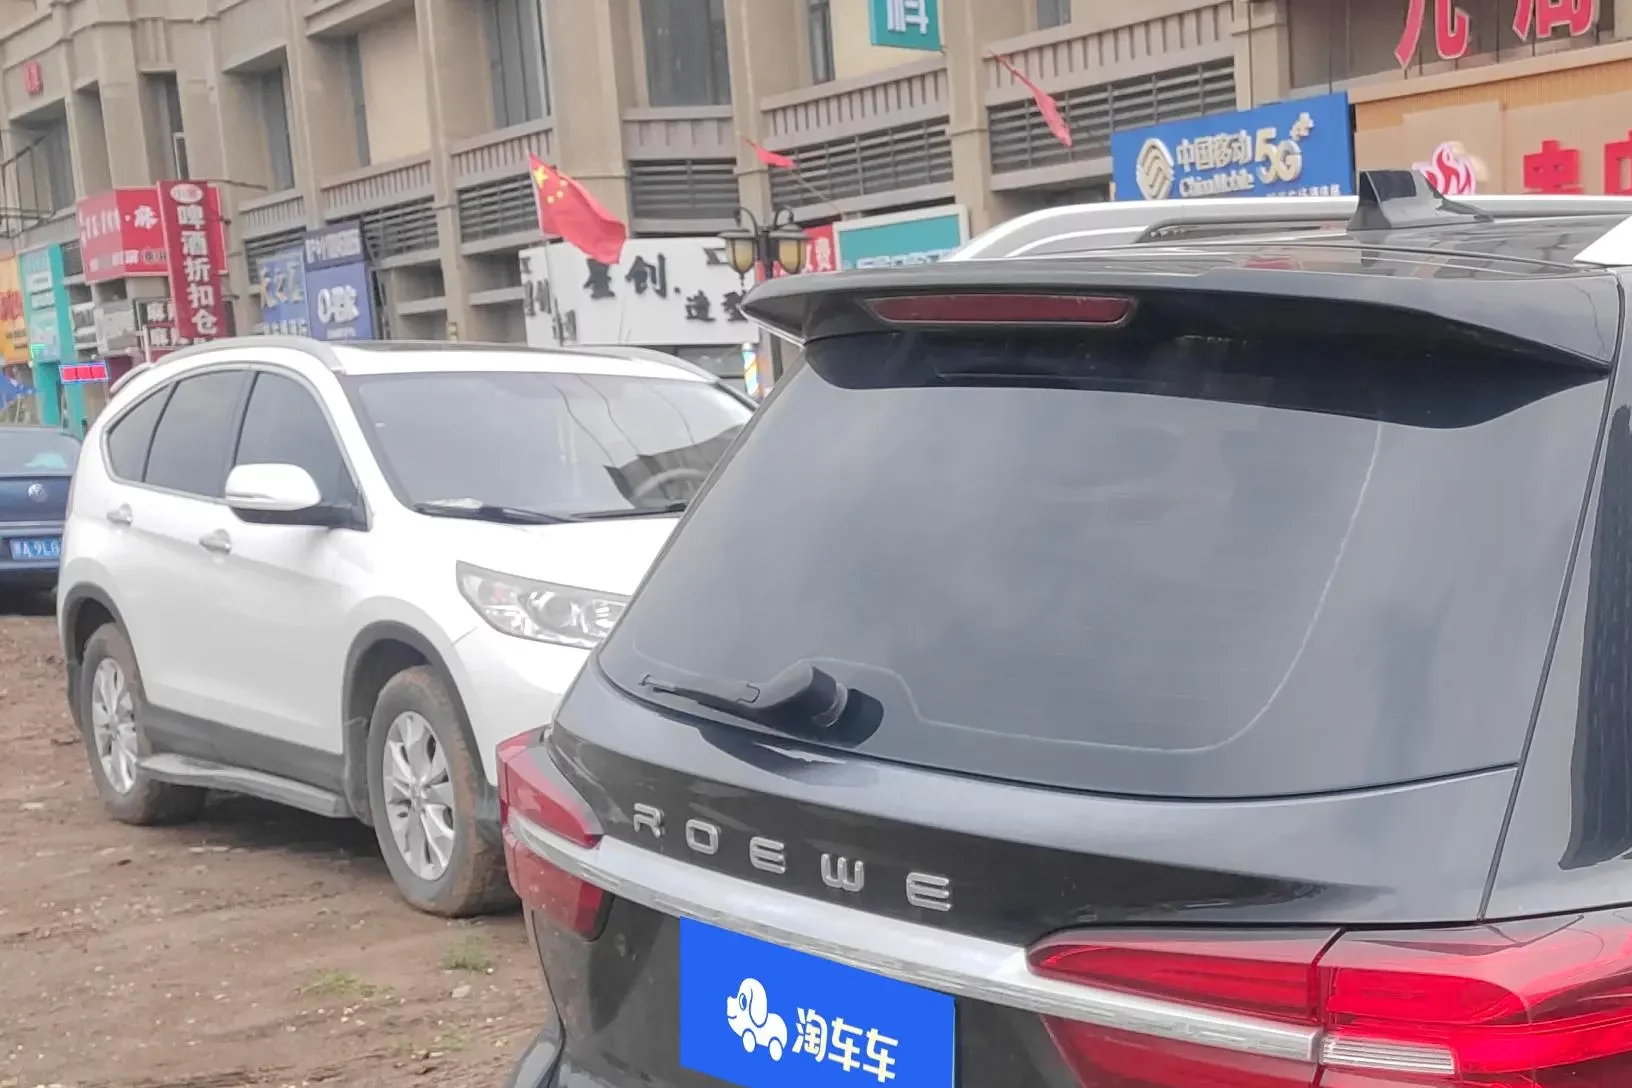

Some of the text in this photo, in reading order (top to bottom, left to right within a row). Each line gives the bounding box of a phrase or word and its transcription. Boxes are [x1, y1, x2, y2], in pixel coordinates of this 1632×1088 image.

[1176, 130, 1253, 172] 中国移动
[633, 803, 952, 912] ROEWE
